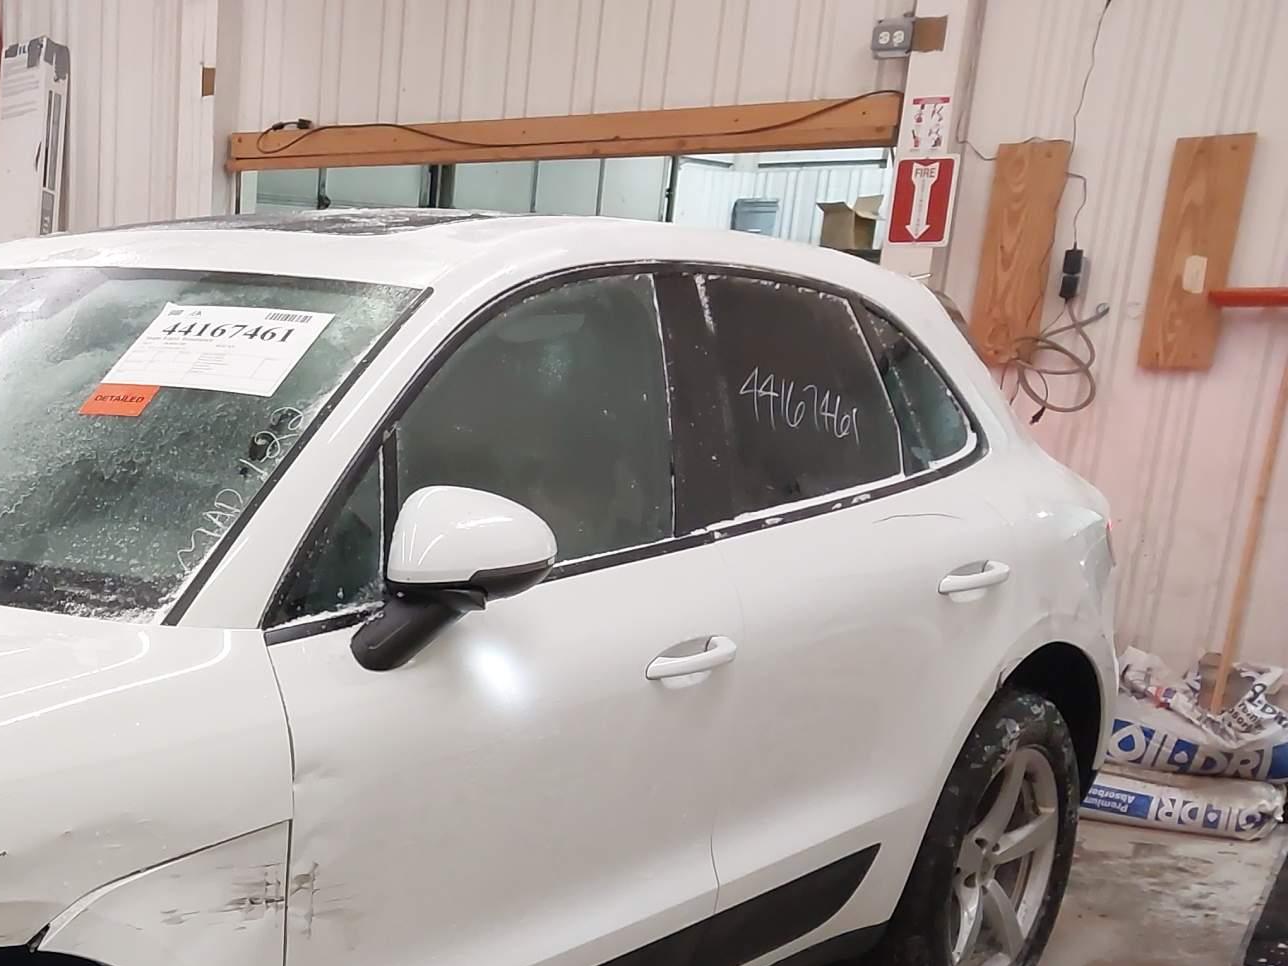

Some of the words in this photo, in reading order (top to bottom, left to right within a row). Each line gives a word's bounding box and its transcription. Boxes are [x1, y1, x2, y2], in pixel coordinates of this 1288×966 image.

[915, 167, 936, 178] FIRE
[162, 321, 296, 343] 44167461
[94, 394, 146, 404] DETAILED
[739, 366, 860, 446] 44167461
